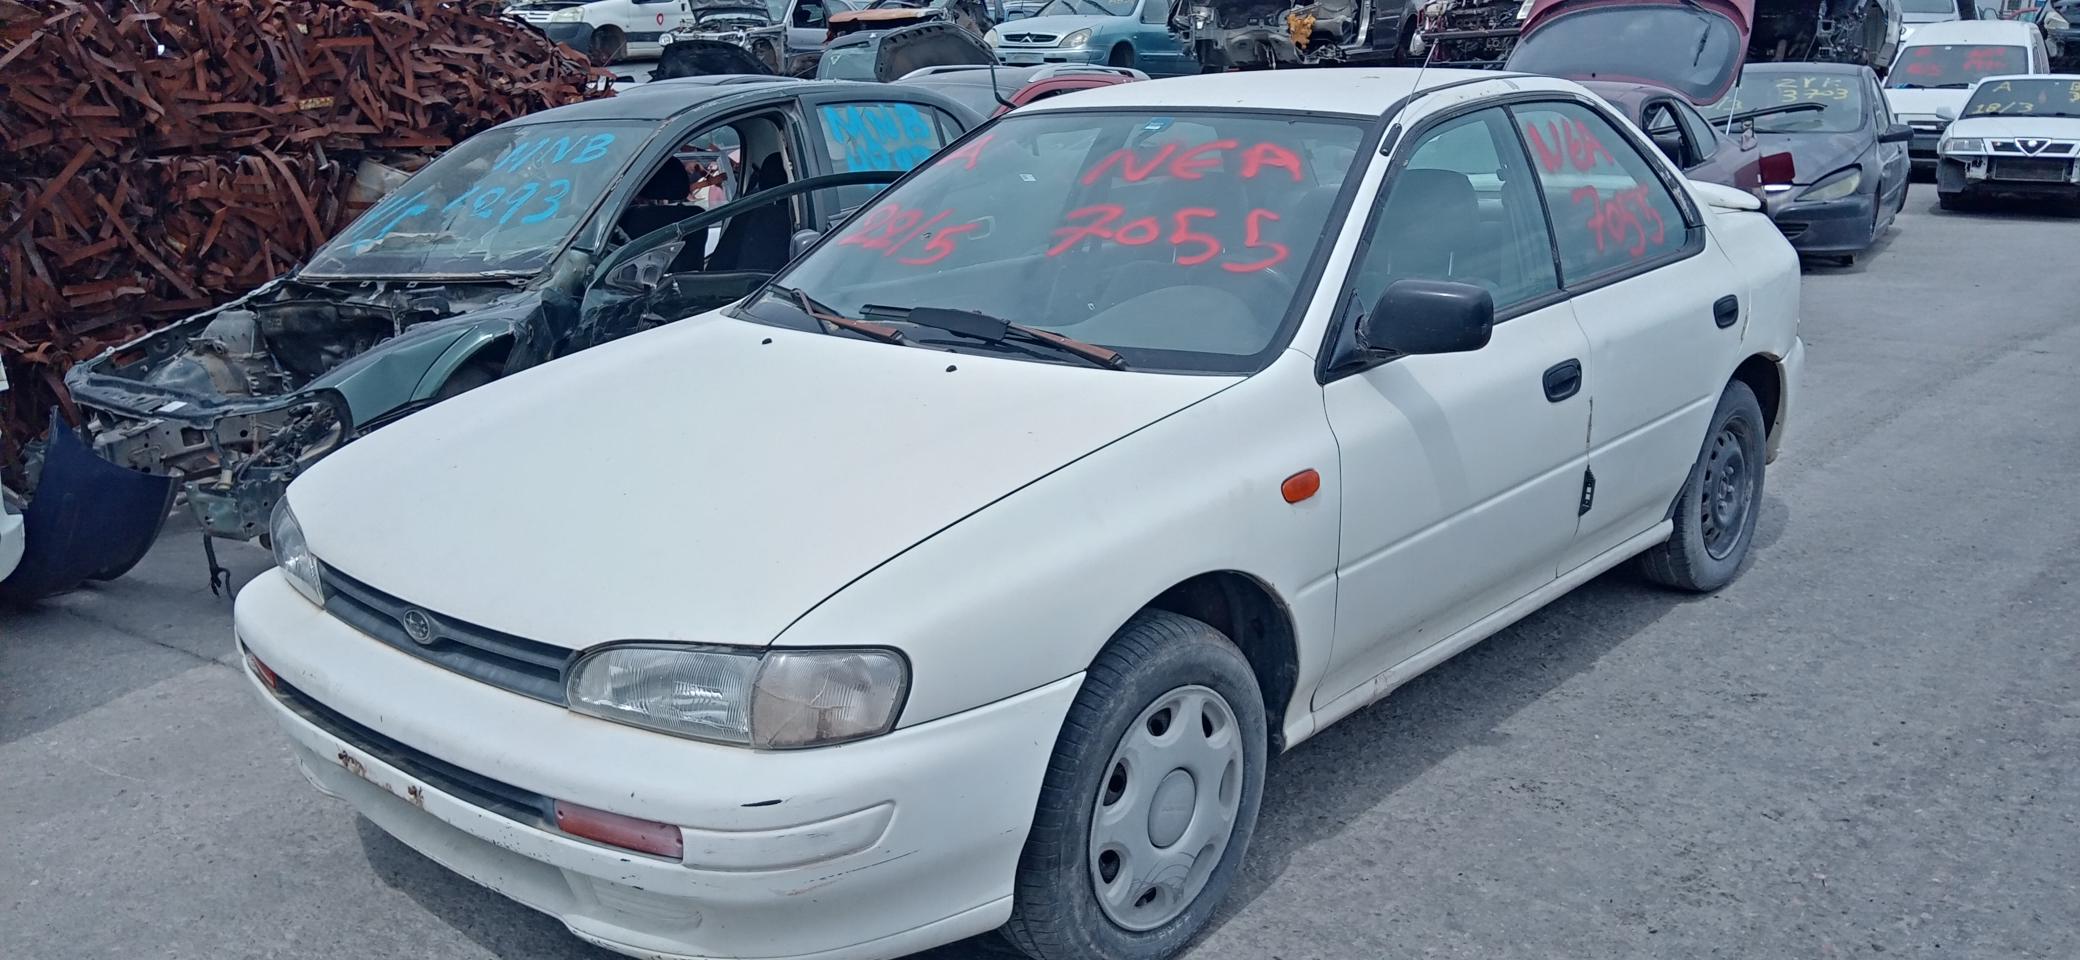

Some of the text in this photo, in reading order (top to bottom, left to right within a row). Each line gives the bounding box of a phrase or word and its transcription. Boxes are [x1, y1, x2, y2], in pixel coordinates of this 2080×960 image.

[1080, 139, 1303, 187] NEA
[1526, 115, 1615, 173] NEA
[1045, 203, 1292, 274] 7055
[1571, 181, 1665, 258] 7055
